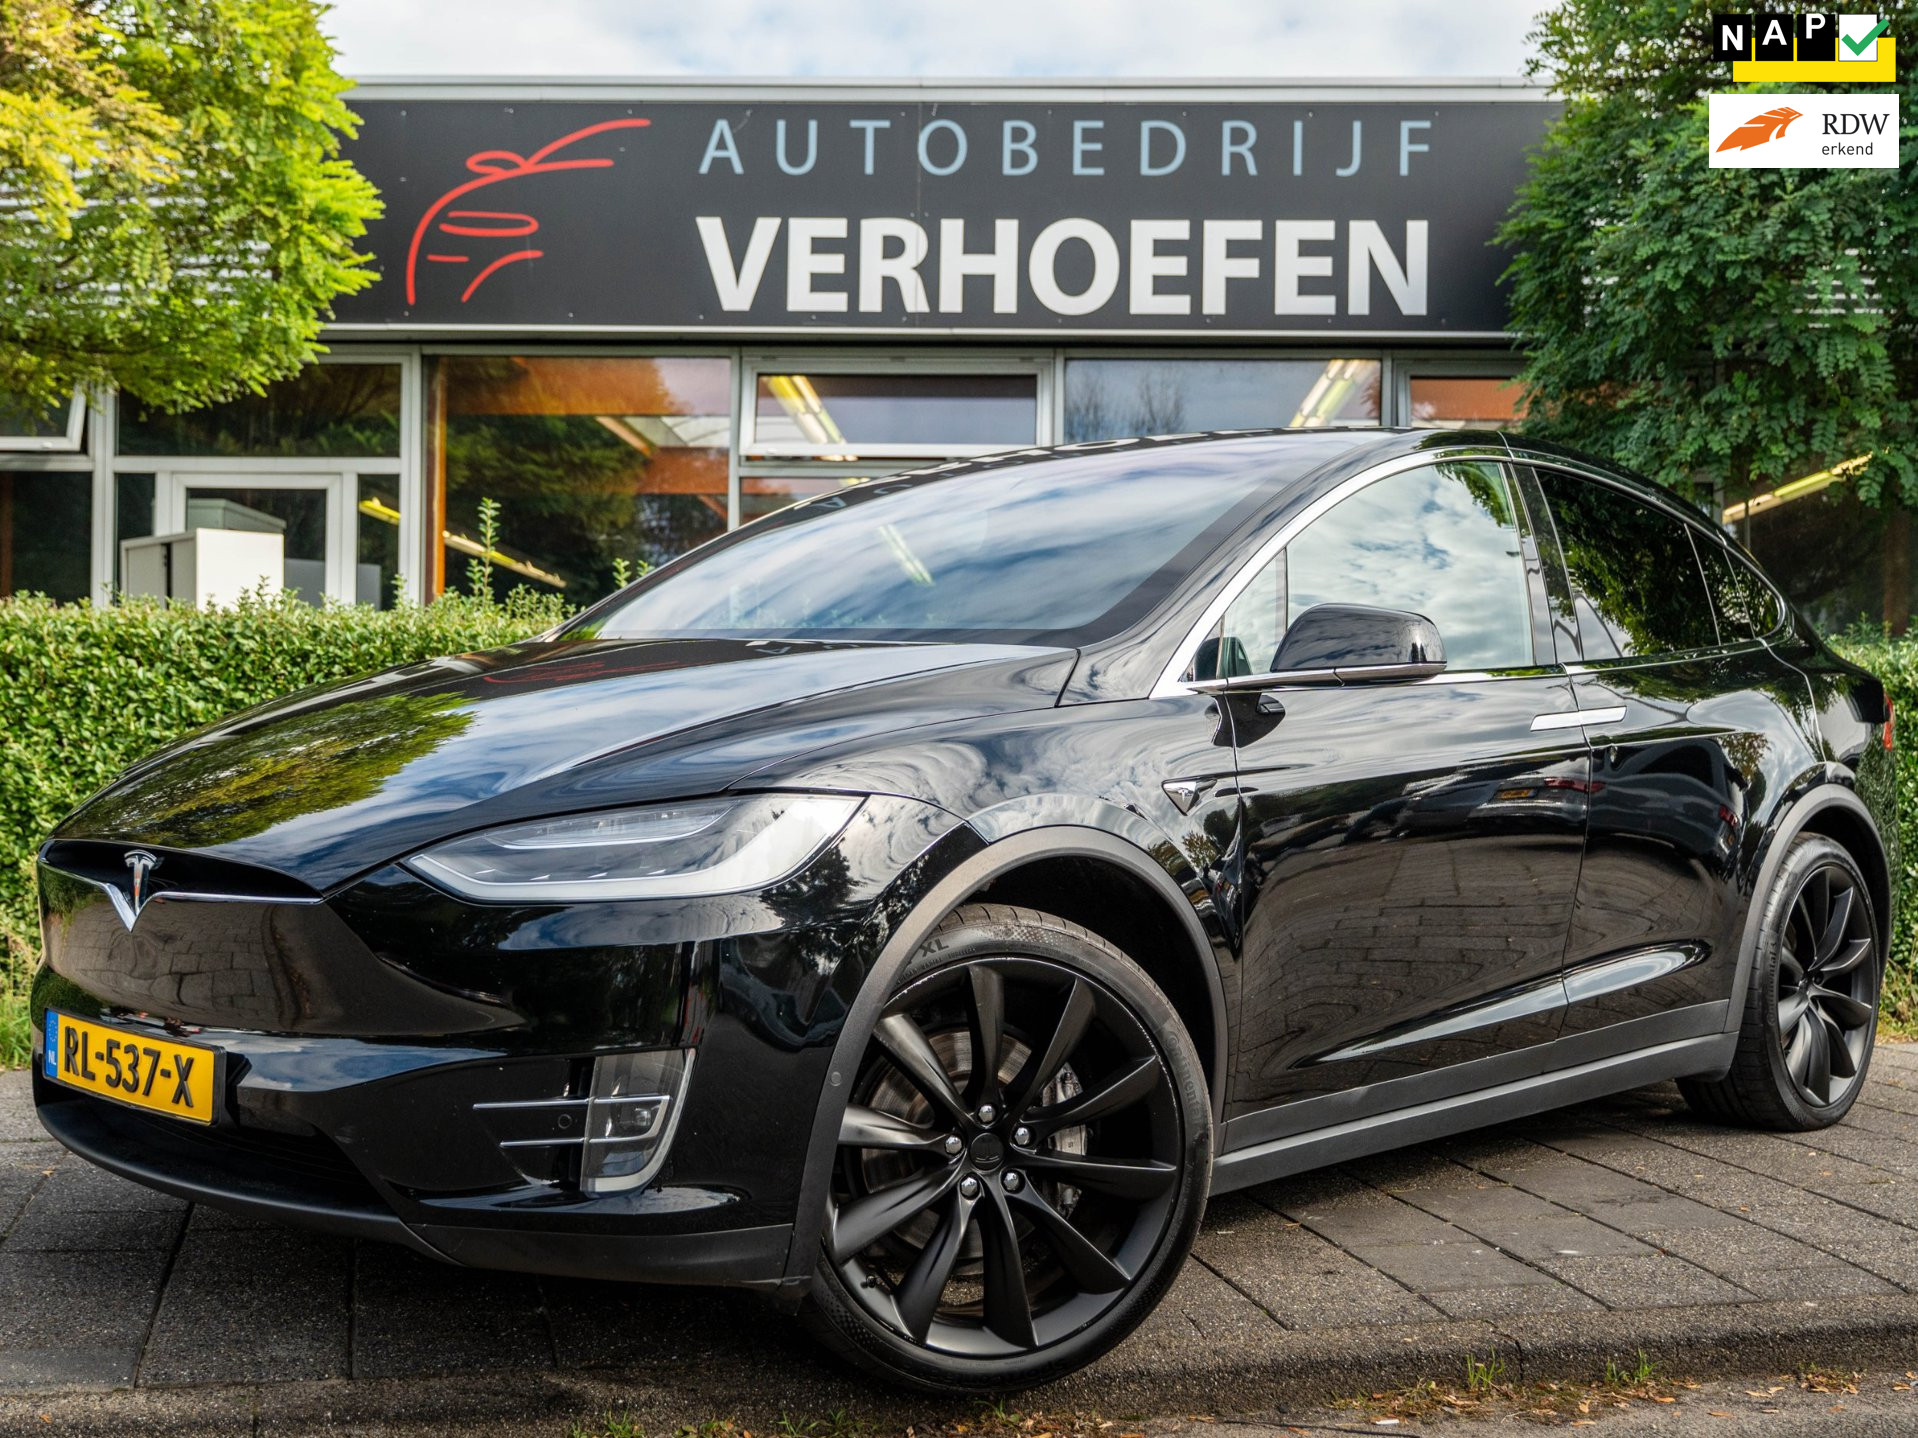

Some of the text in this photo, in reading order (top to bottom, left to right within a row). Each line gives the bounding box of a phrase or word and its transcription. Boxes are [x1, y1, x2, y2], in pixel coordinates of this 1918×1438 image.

[699, 118, 1432, 178] AUTOBEDRIJF
[695, 216, 1429, 316] VERHOEFEN
[920, 938, 949, 957] XL
[64, 1026, 195, 1108] RL-537-X
